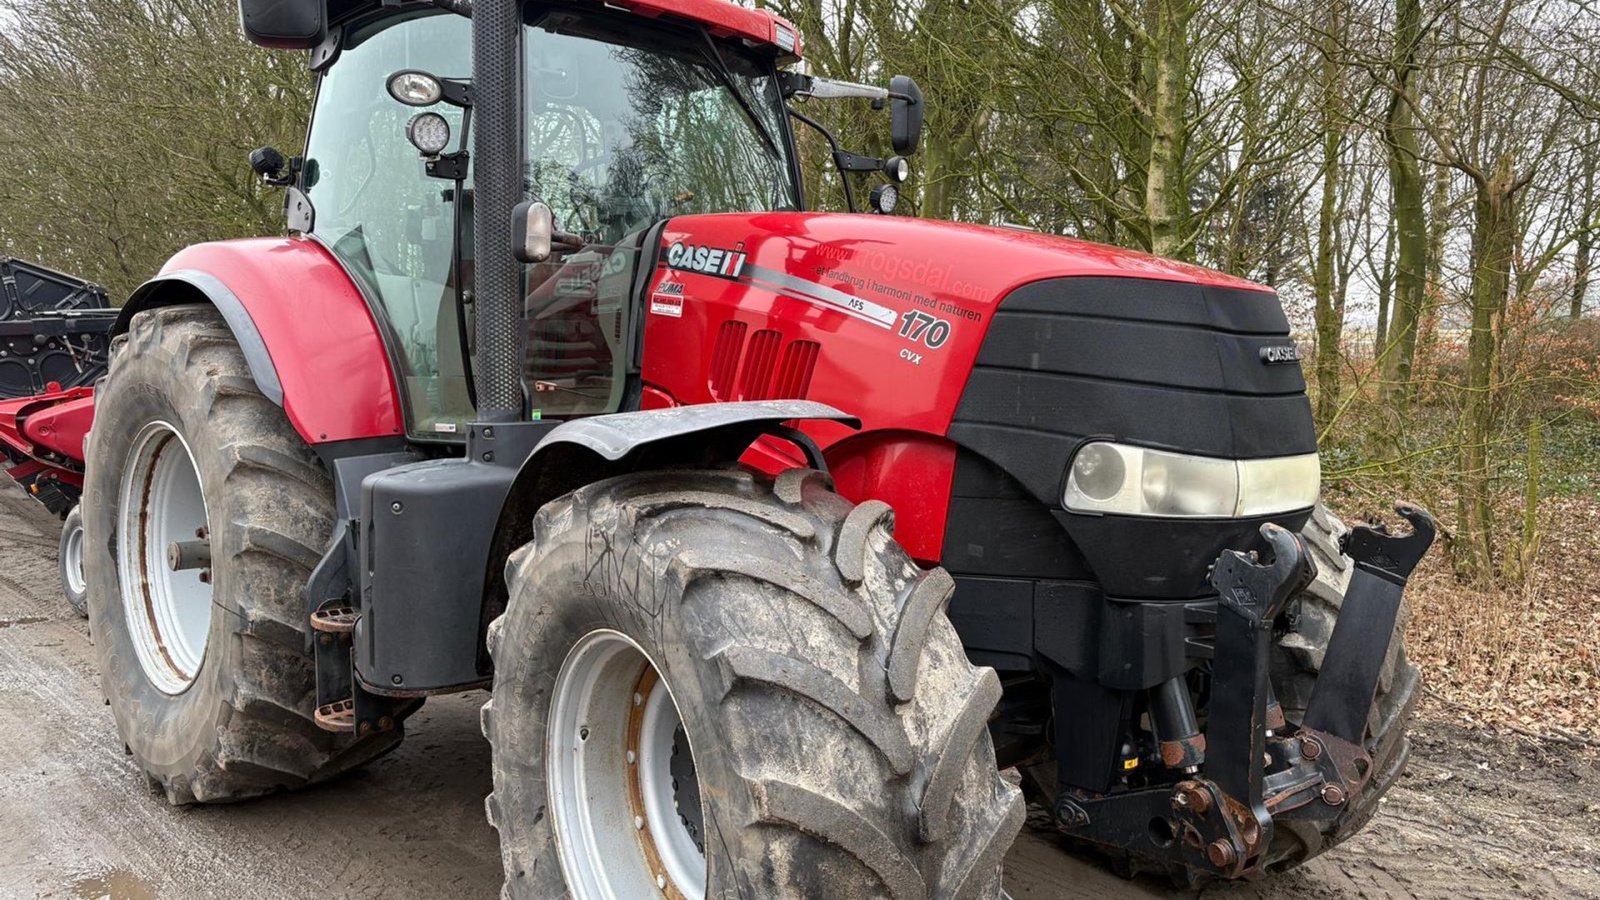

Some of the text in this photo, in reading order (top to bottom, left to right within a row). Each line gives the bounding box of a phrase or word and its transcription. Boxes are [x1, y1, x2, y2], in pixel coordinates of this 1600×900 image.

[668, 243, 724, 273] CASE
[658, 283, 684, 294] PUMA
[872, 280, 913, 301] harmoni
[914, 294, 938, 309] med
[939, 302, 982, 323] naturen
[848, 298, 865, 311] AFS
[898, 308, 951, 349] 170
